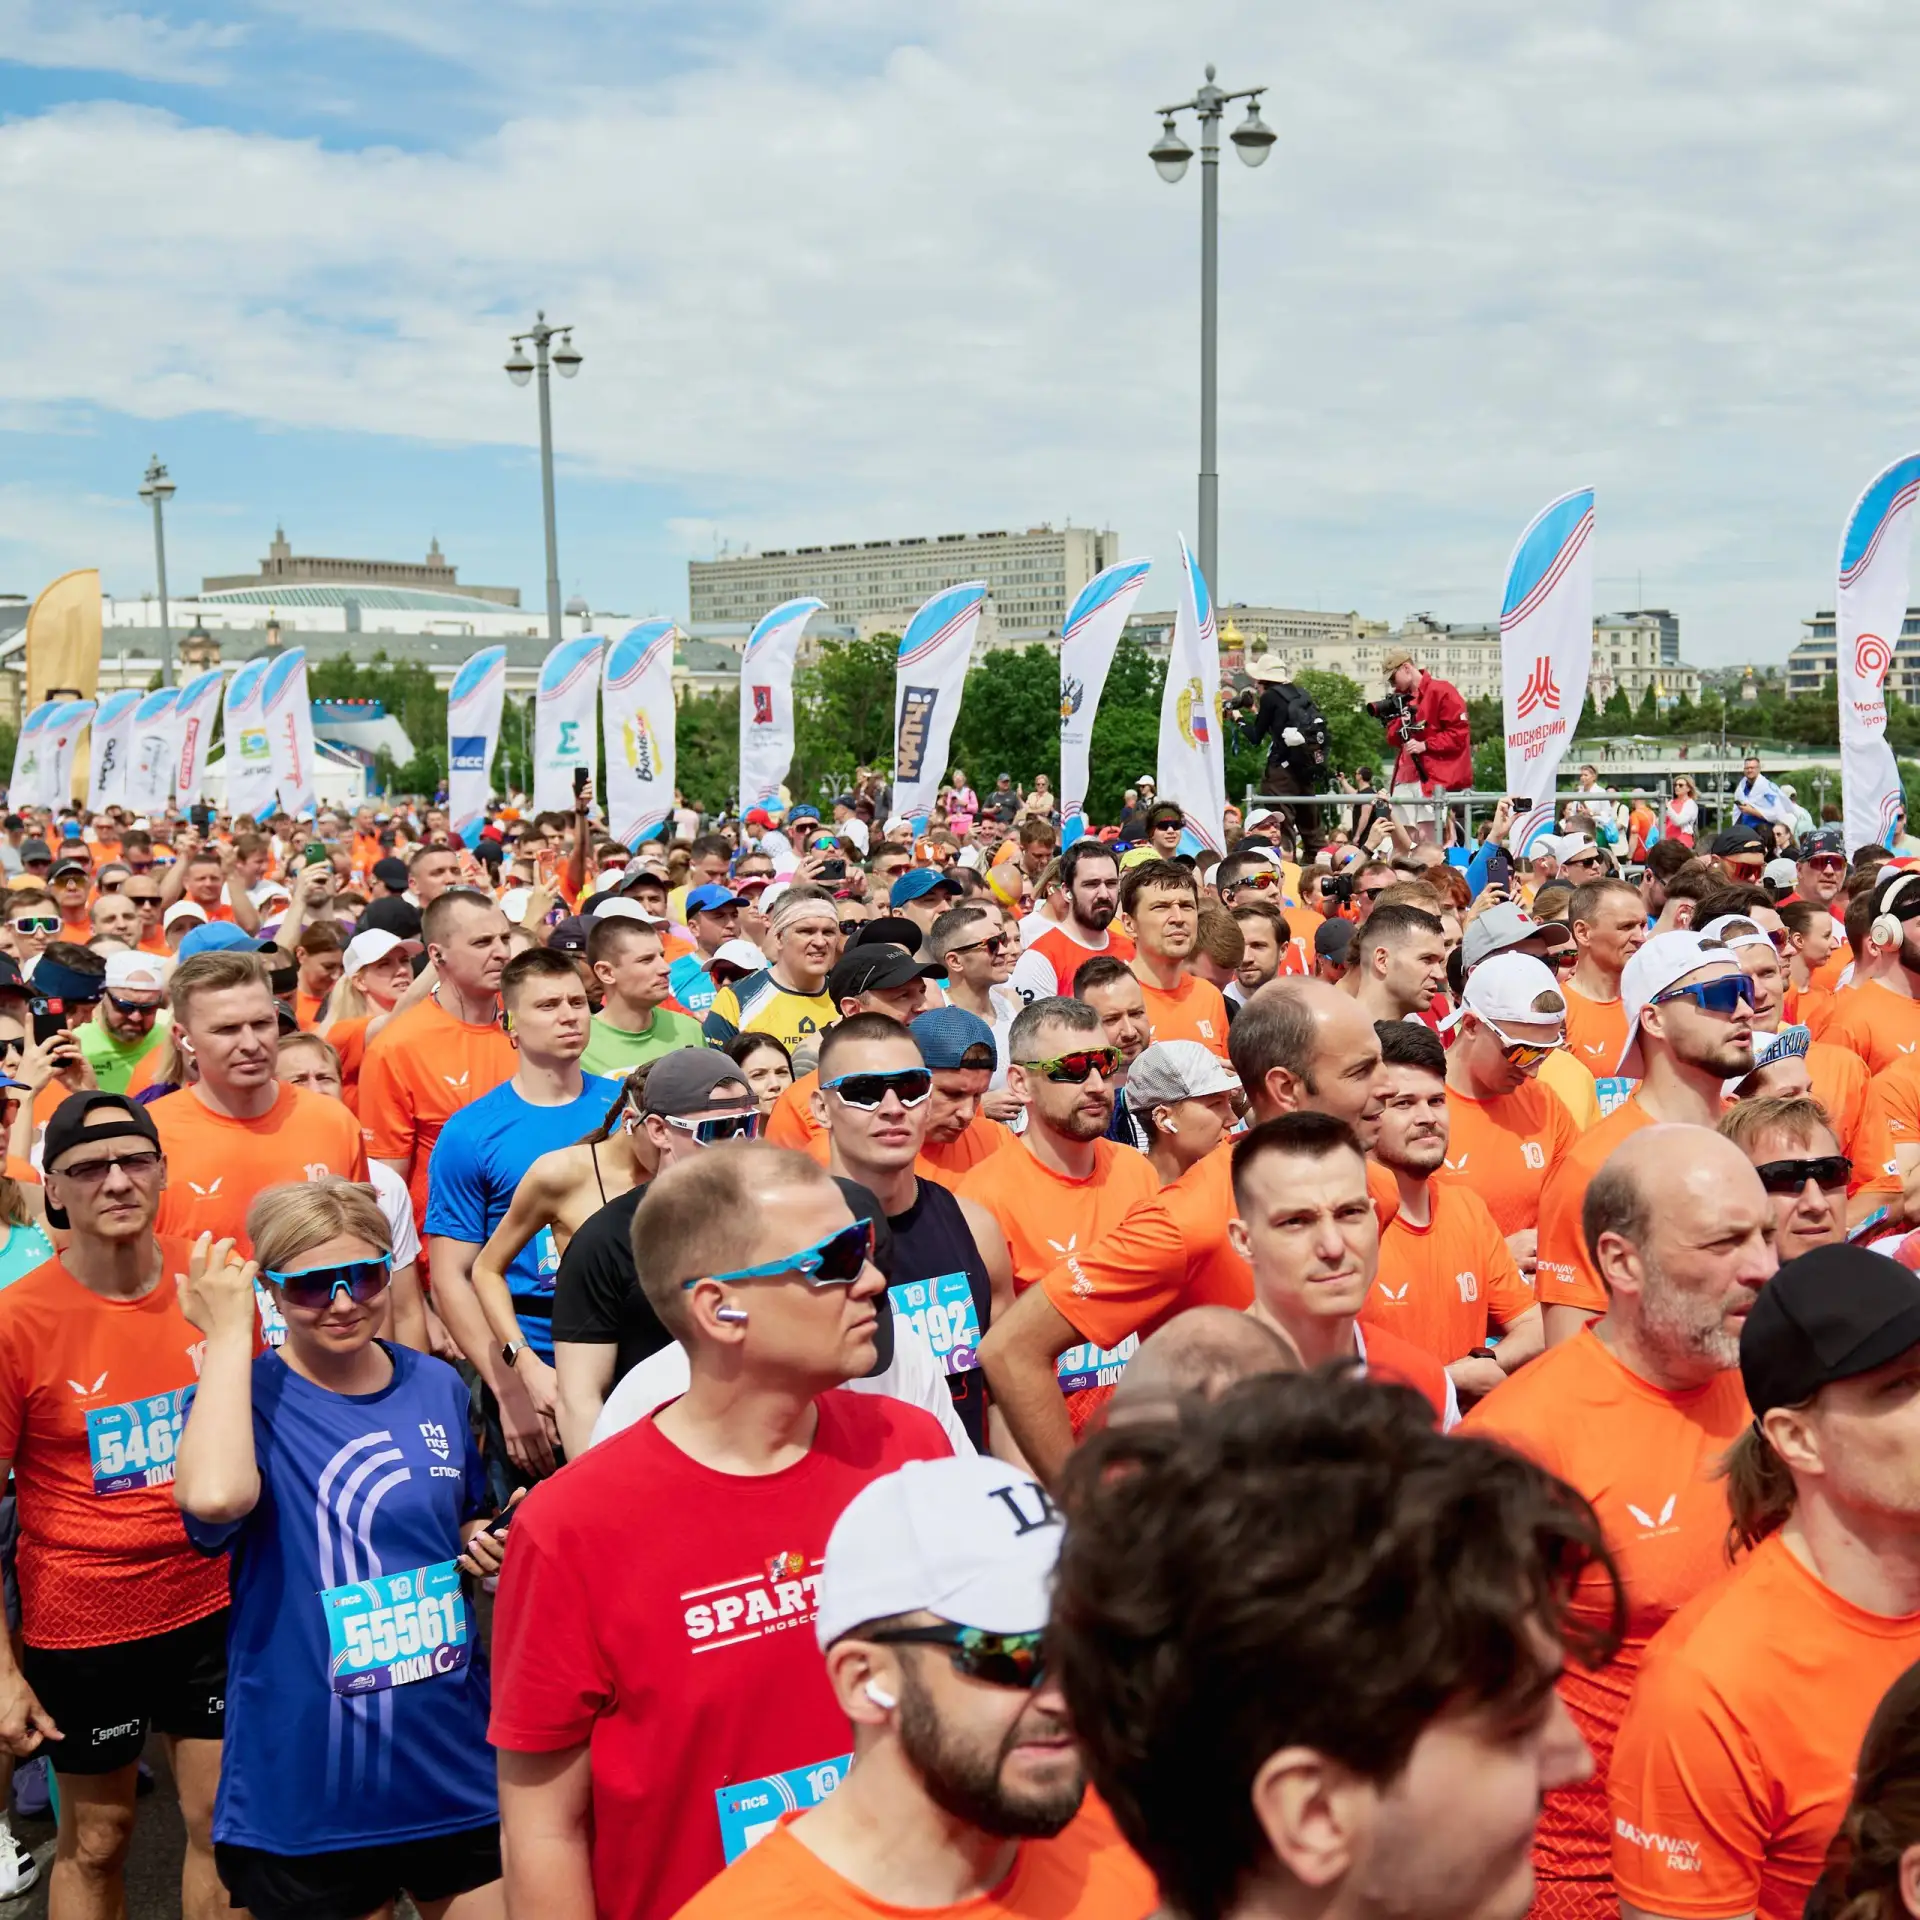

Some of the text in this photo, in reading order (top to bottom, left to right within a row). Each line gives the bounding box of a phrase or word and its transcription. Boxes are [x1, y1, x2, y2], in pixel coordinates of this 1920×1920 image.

[1520, 1142, 1545, 1170] 10
[1455, 1271, 1478, 1303] 10
[143, 1462, 176, 1488] 10K
[343, 1592, 458, 1669] 55561
[387, 1653, 433, 1687] 10KM
[99, 1722, 133, 1741] SPORT
[741, 1794, 769, 1812] ПСБ
[1667, 1853, 1702, 1872] RUN
